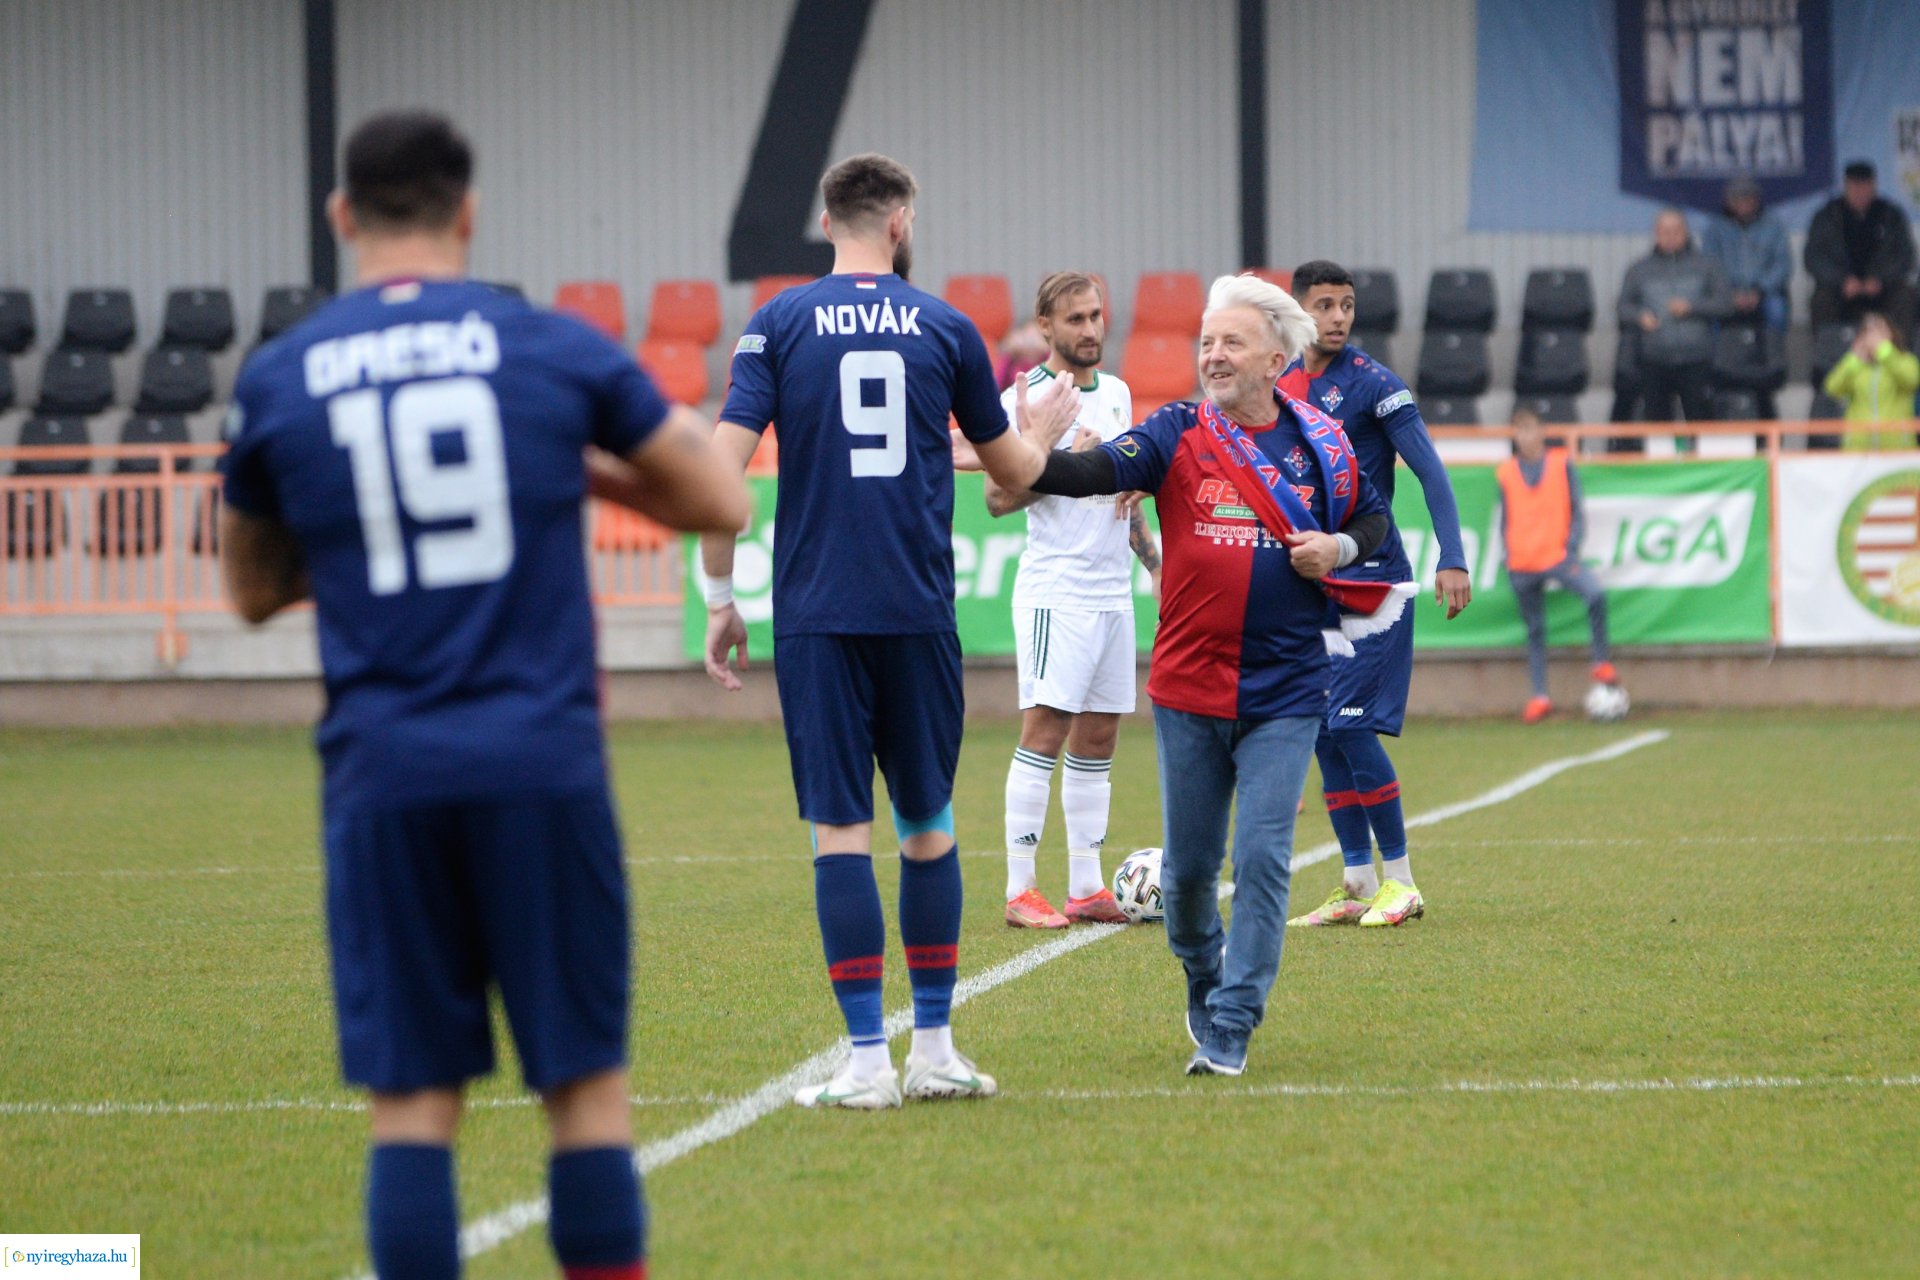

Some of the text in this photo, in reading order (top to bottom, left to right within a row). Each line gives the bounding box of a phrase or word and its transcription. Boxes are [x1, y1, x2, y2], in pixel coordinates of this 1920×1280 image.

[1647, 28, 1803, 105] NEM
[815, 297, 922, 336] NOVÁK
[840, 351, 907, 478] 9
[328, 375, 515, 597] 19
[1195, 522, 1259, 540] LERTON
[1580, 517, 1730, 566] IGA
[1340, 708, 1363, 716] JAKO
